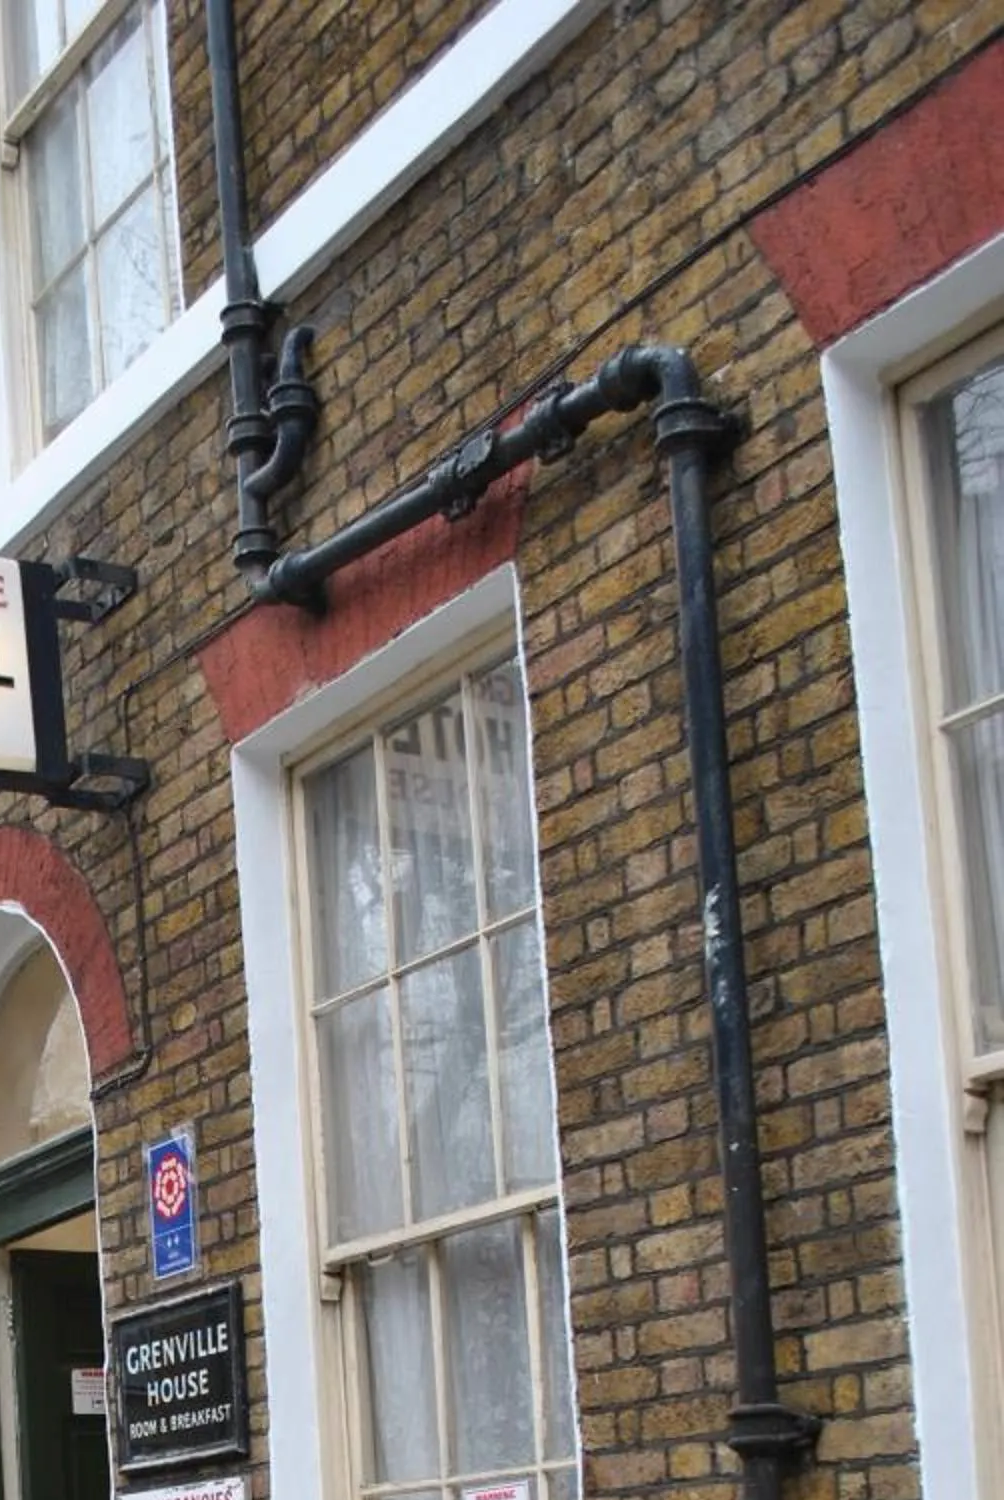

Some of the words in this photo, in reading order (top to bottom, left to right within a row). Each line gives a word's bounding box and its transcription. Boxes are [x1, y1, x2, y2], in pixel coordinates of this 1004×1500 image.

[126, 1322, 229, 1374] GRENVILLE
[147, 1368, 210, 1407] HOUSE
[129, 1420, 157, 1440] ROOM
[159, 1417, 168, 1434] &
[169, 1403, 232, 1431] BREAKFAST
